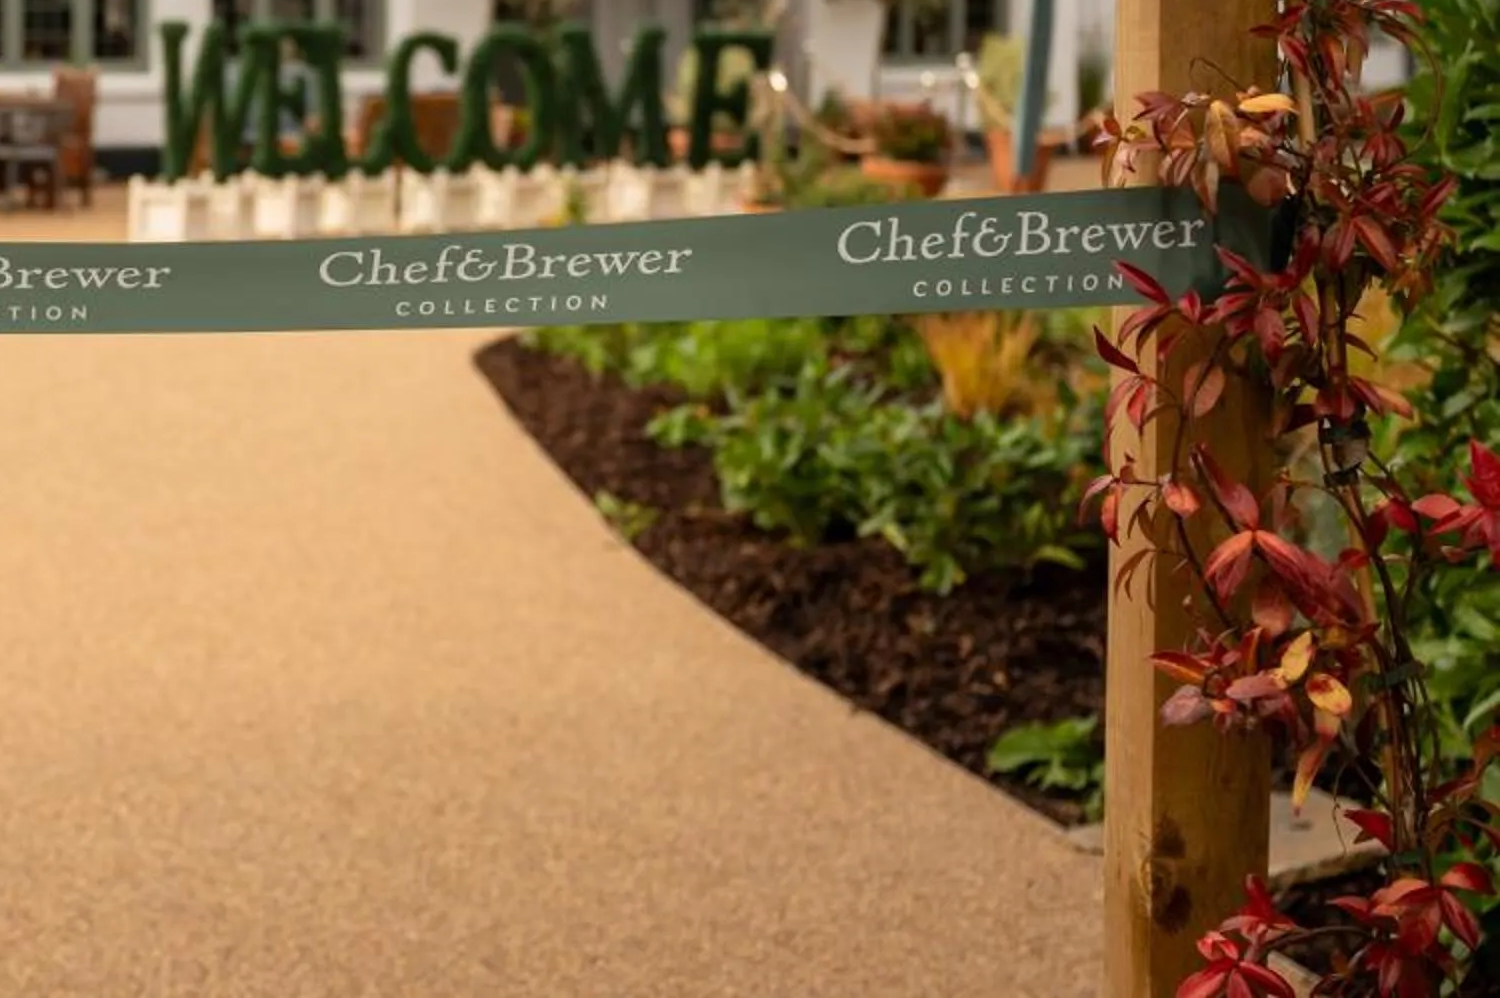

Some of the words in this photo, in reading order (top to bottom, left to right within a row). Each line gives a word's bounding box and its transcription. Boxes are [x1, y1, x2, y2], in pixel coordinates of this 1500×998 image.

[836, 211, 1204, 264] Chef&Brewer
[318, 243, 693, 288] Chef&Brewer
[913, 272, 1124, 298] COLLECTION
[395, 294, 608, 317] COLLECTION
